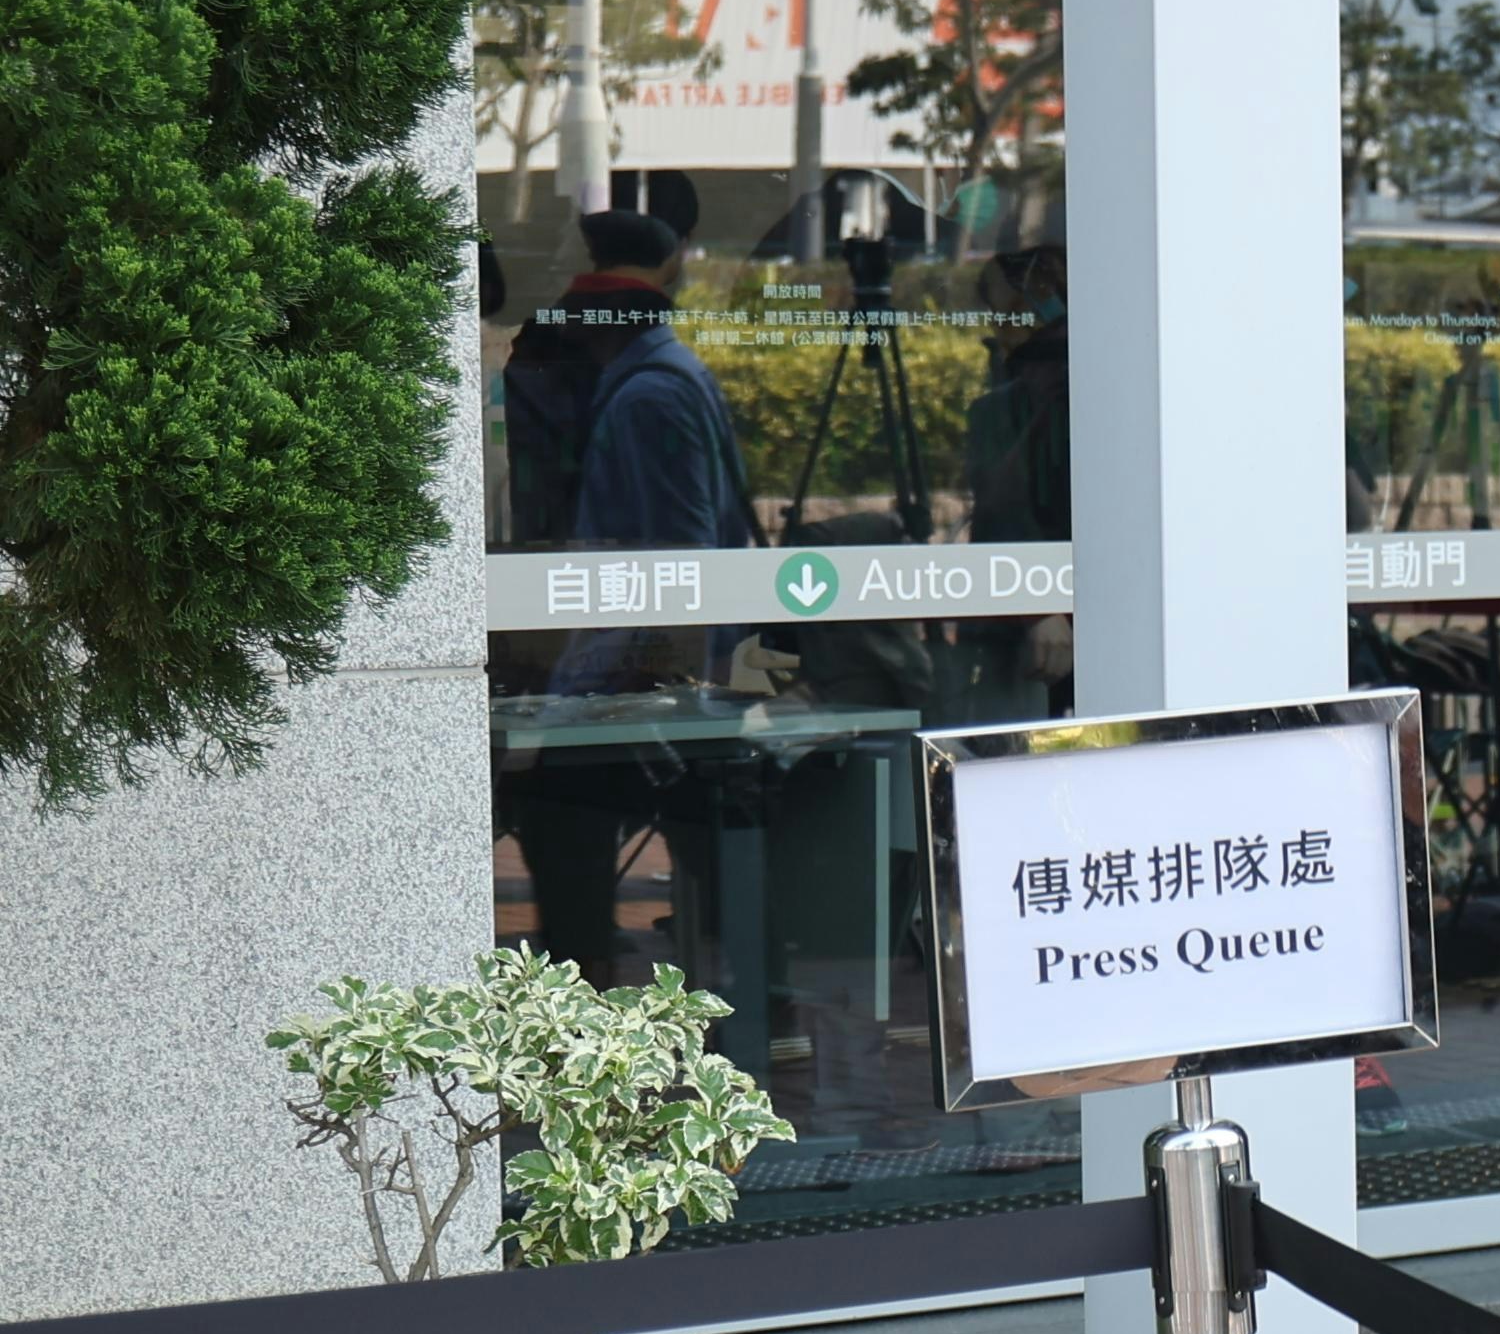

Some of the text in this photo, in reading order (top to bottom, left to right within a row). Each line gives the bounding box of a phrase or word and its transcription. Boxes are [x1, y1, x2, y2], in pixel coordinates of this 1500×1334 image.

[1369, 314, 1423, 329] Mondays
[1426, 314, 1438, 327] to
[1424, 331, 1463, 345] Closed
[1466, 334, 1482, 345] on
[547, 561, 702, 614] 自動門
[858, 554, 1074, 602] Auto Doo
[1346, 540, 1466, 589] 自動門
[1011, 828, 1336, 919] 傳媒排隊處
[1032, 923, 1326, 985] Press Queue
